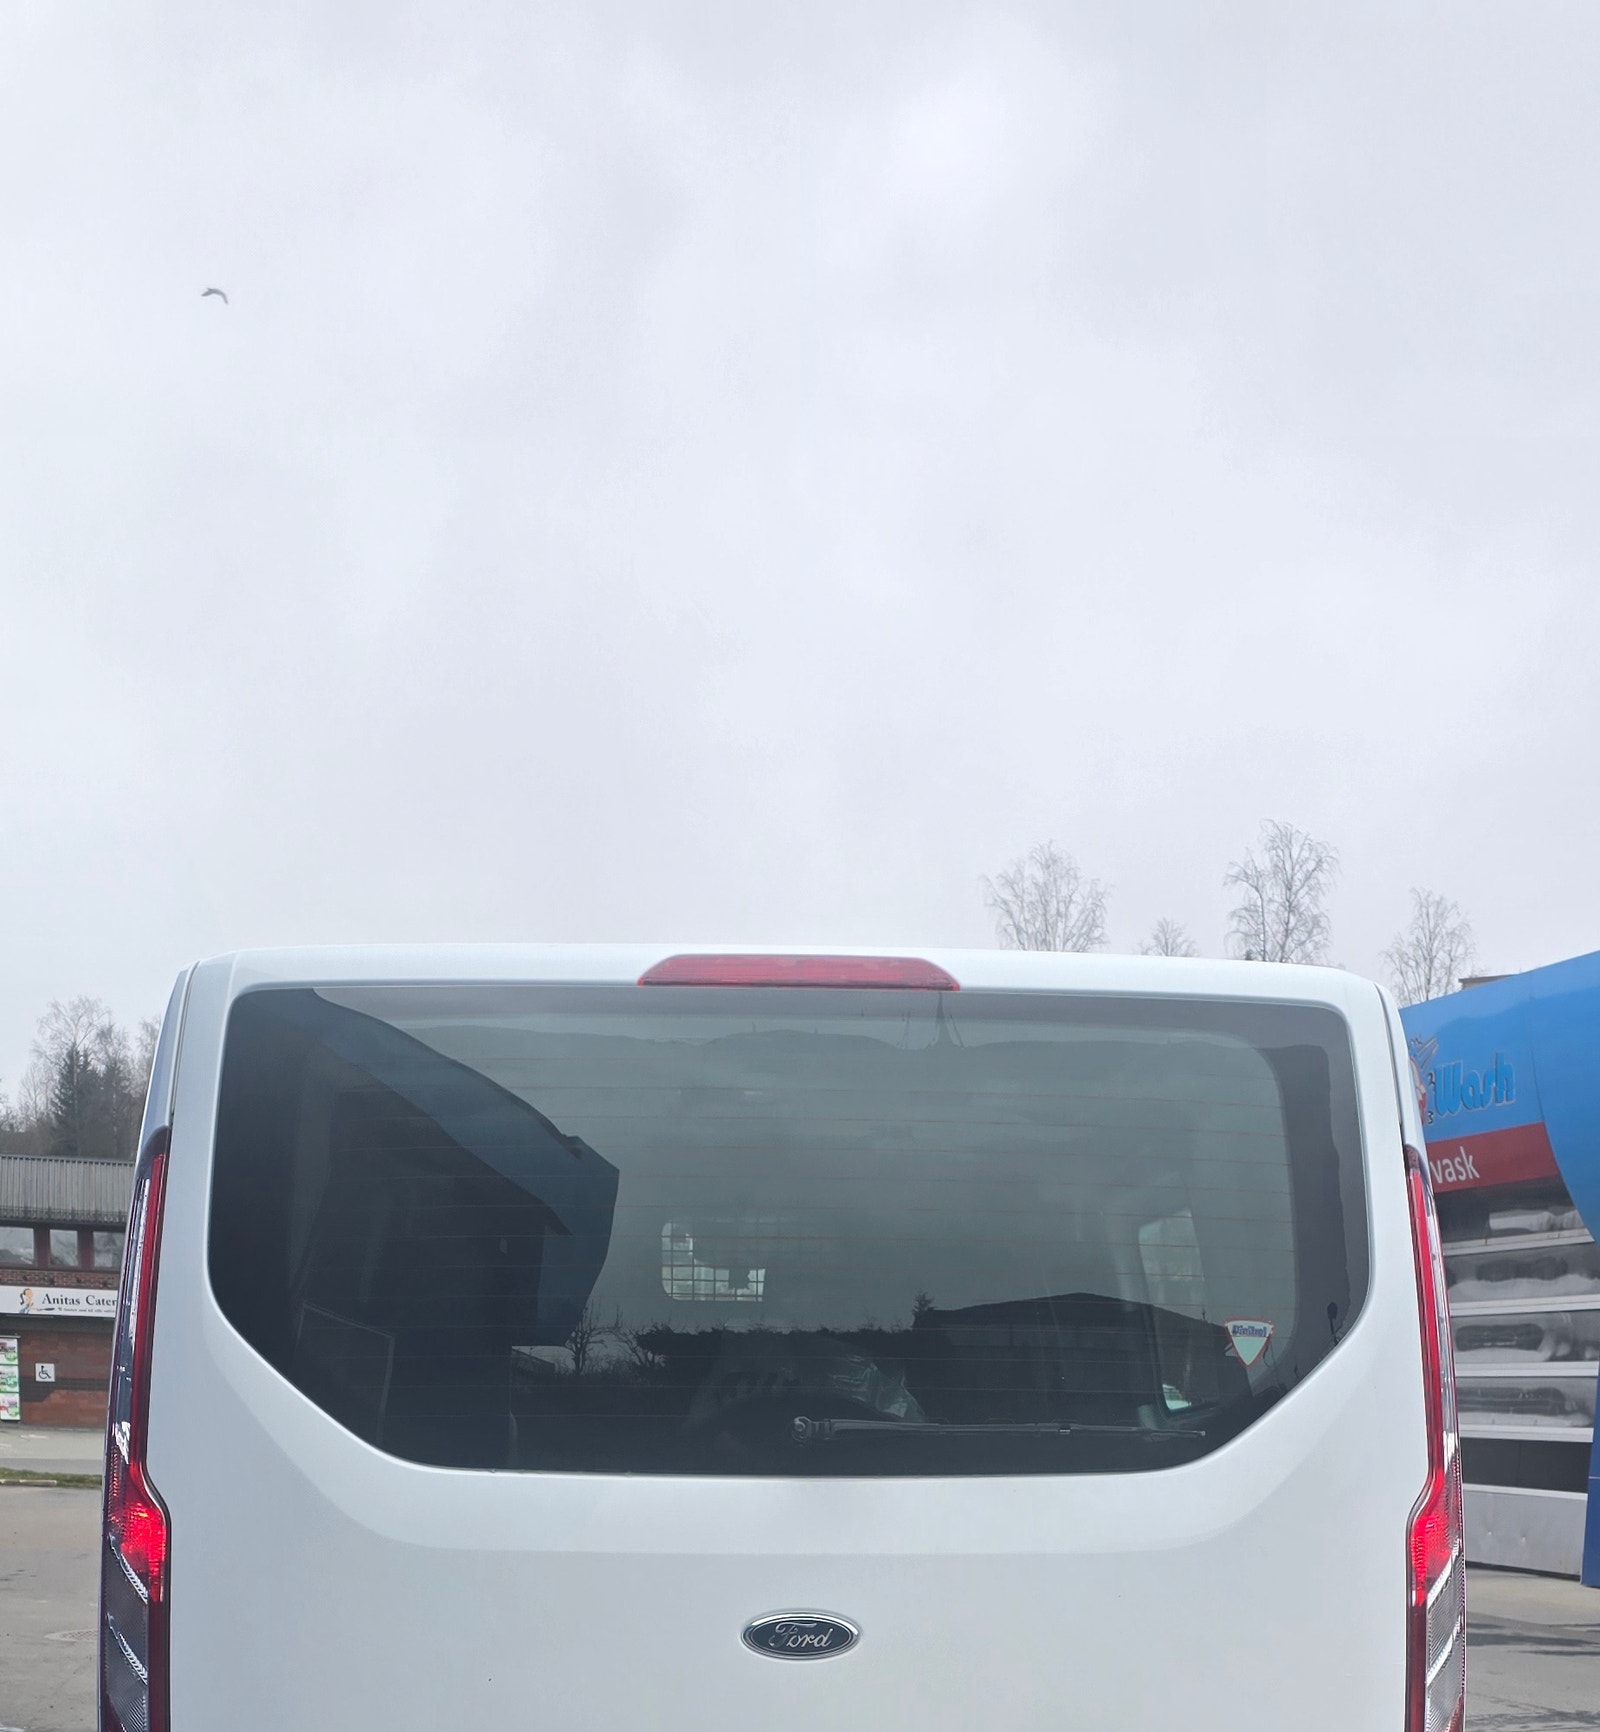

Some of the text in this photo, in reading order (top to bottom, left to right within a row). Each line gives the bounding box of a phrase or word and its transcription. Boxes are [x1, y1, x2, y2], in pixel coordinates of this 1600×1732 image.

[1435, 1051, 1516, 1117] Wash
[42, 1294, 81, 1305] Anitas
[768, 1621, 834, 1648] Ford
